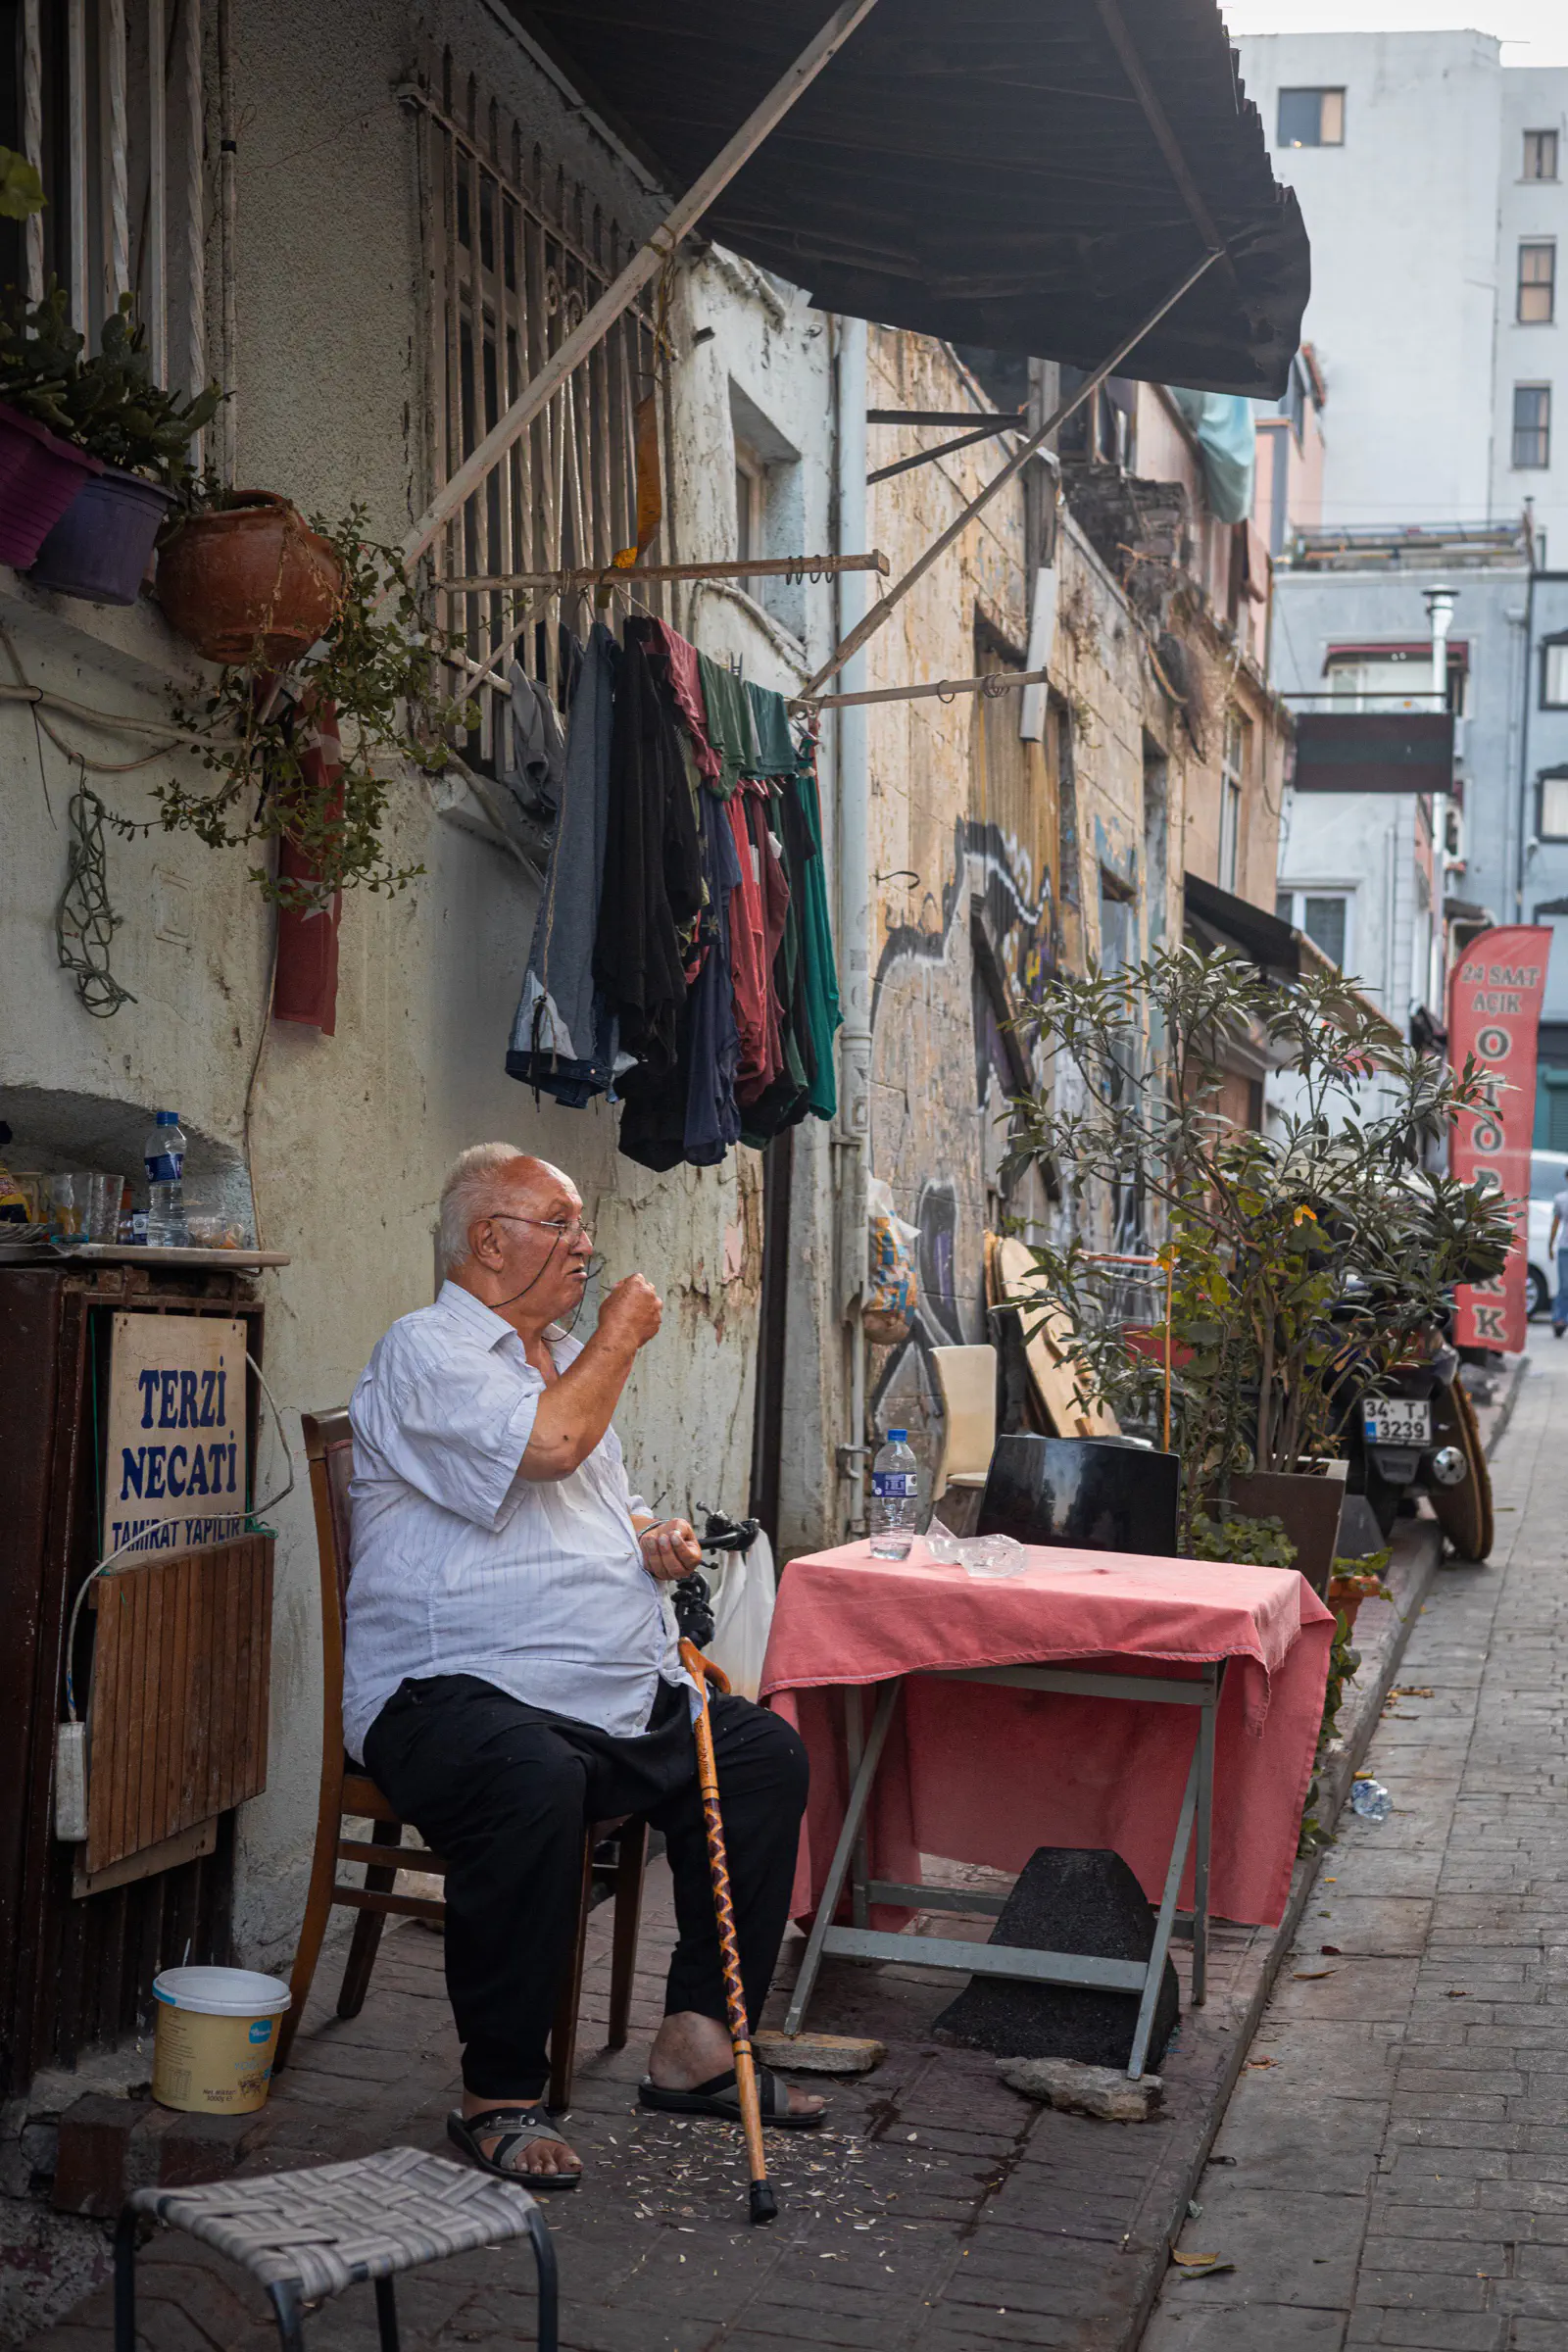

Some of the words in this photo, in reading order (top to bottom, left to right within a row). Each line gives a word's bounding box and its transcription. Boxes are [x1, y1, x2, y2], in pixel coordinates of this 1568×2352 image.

[1461, 963, 1485, 984] 24
[1489, 965, 1541, 988] SAAT
[1472, 991, 1522, 1017] AÇIK
[138, 1355, 226, 1429] TERZİ
[1366, 1401, 1389, 1418] 34
[1403, 1402, 1428, 1419] TJ
[1380, 1421, 1425, 1439] 3239
[120, 1430, 237, 1500] NECATİ
